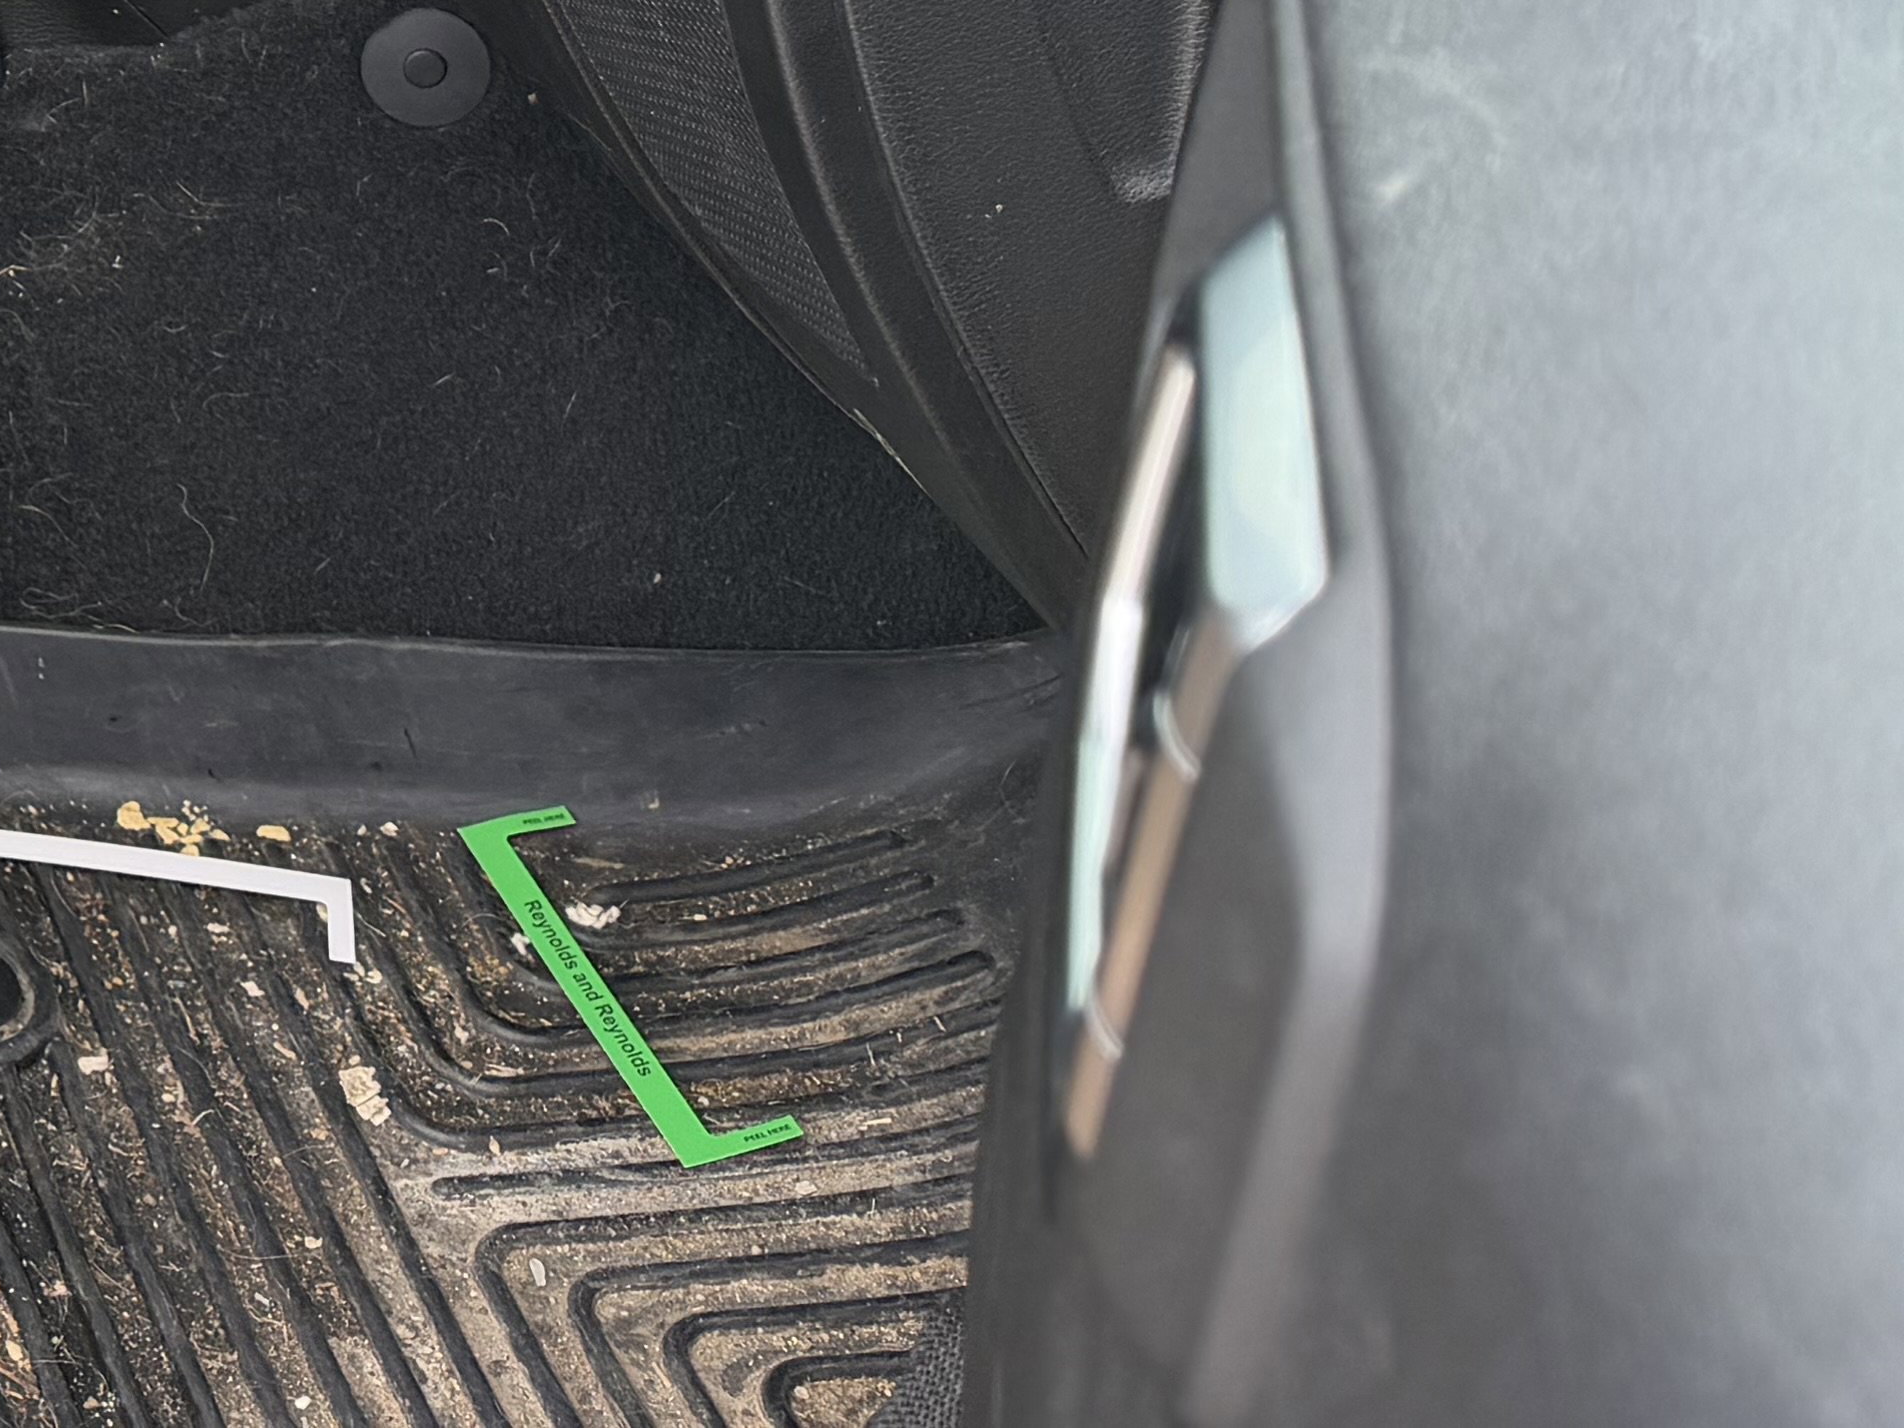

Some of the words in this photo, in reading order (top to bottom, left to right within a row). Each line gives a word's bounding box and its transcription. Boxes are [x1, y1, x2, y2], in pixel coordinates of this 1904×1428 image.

[524, 899, 579, 971] Reynolds
[573, 973, 599, 1003] and
[594, 1003, 652, 1078] Reynolds
